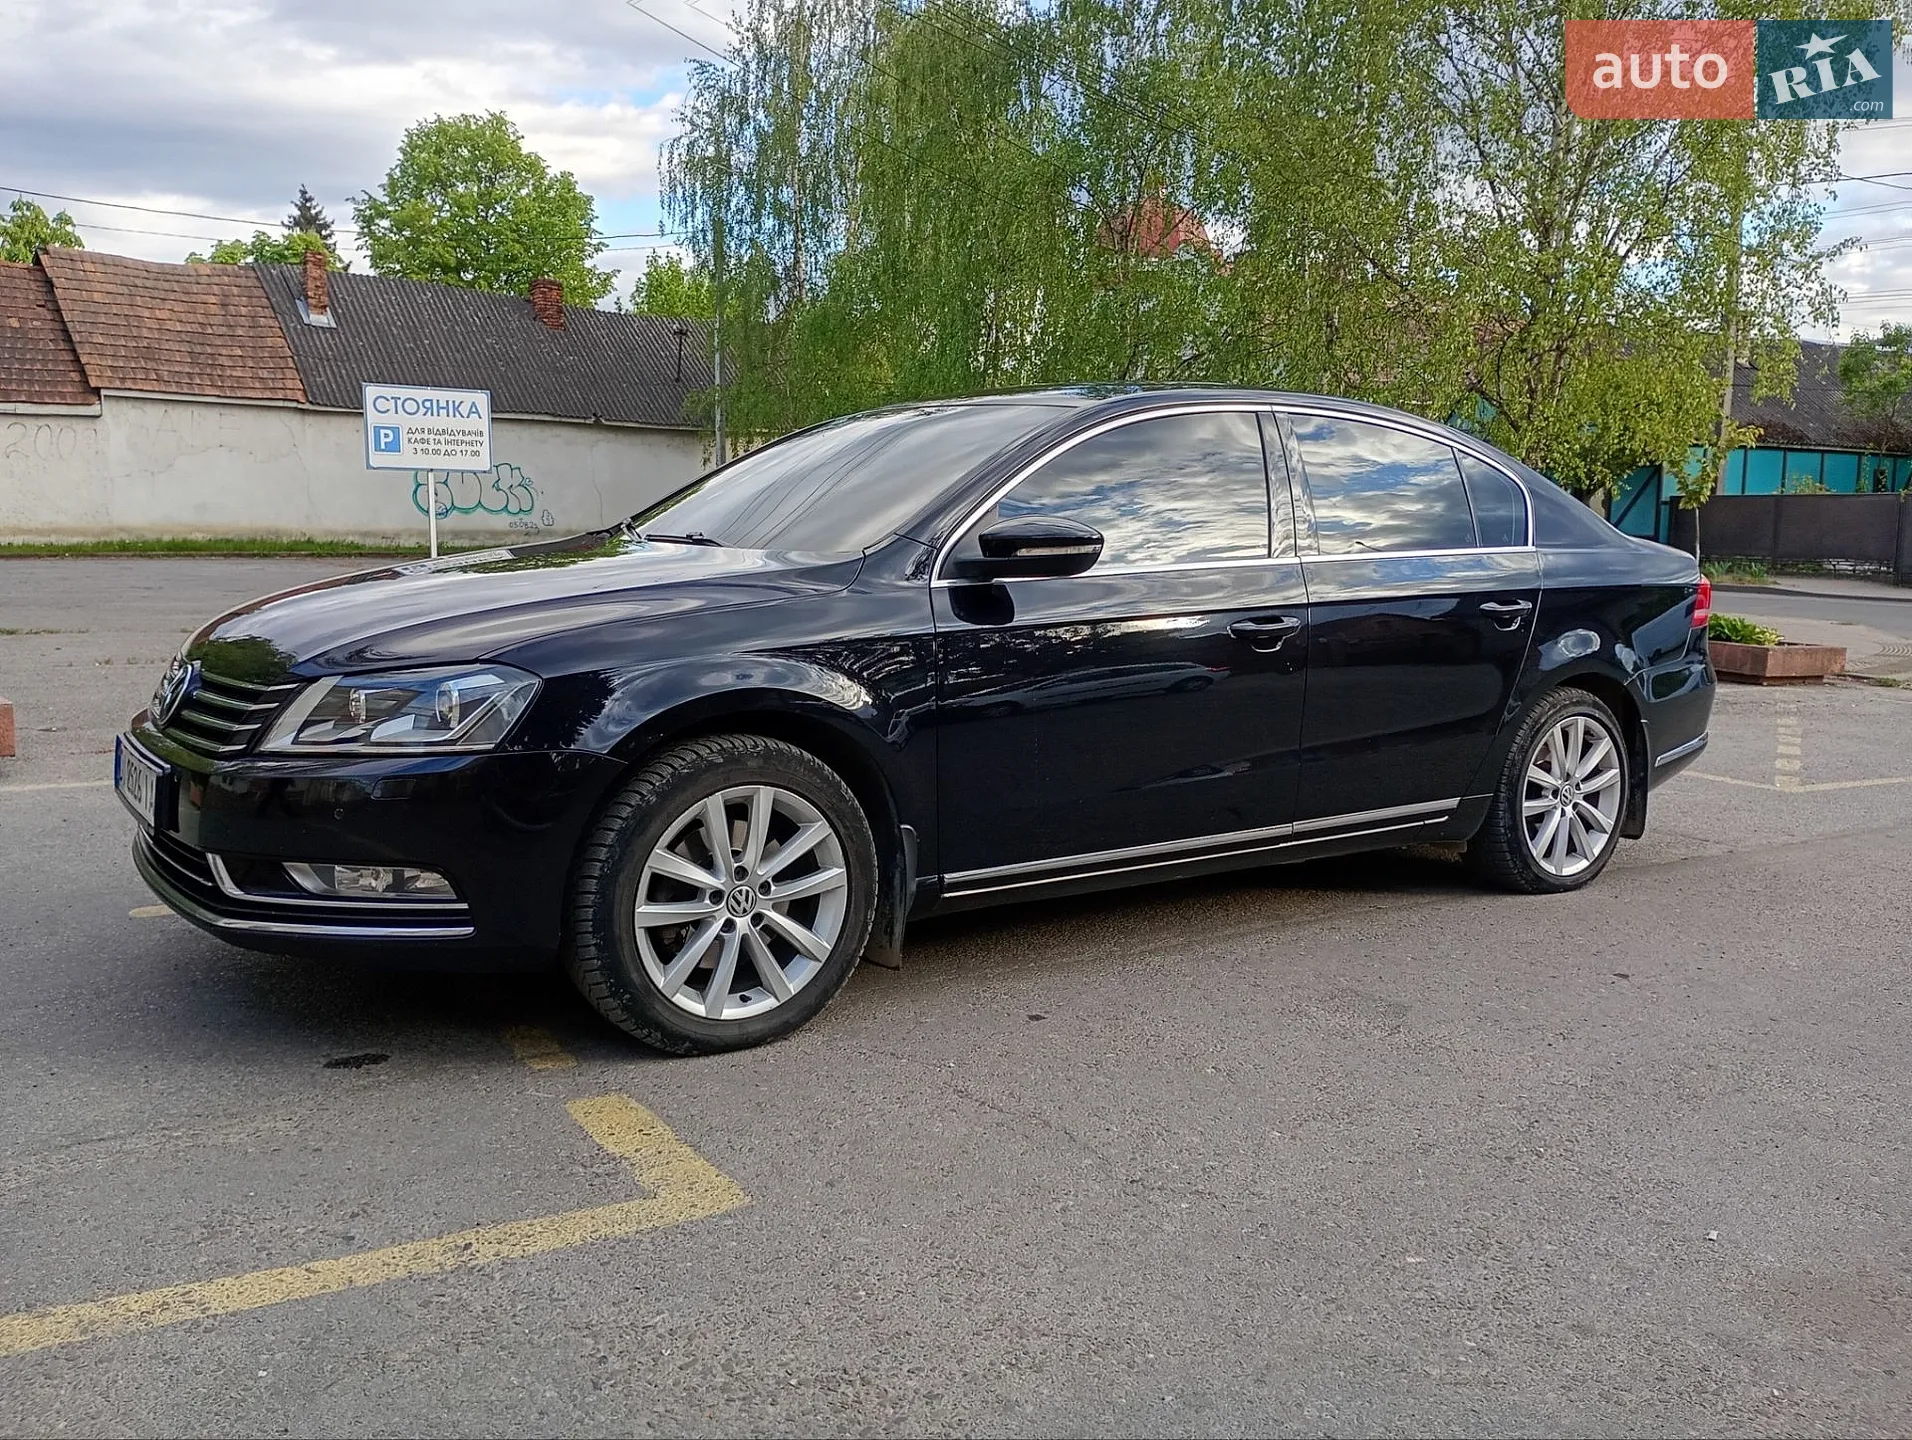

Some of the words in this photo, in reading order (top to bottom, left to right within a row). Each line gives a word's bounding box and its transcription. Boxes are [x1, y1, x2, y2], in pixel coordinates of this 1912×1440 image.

[372, 395, 483, 420] СТОЯНКА
[406, 427, 426, 435] ДЛЯ
[380, 428, 394, 450] P
[407, 437, 431, 446] КАФЕ
[433, 438, 443, 446] ТА
[420, 447, 441, 456] 10.00
[443, 448, 458, 457] ДО
[460, 449, 481, 457] 17.00
